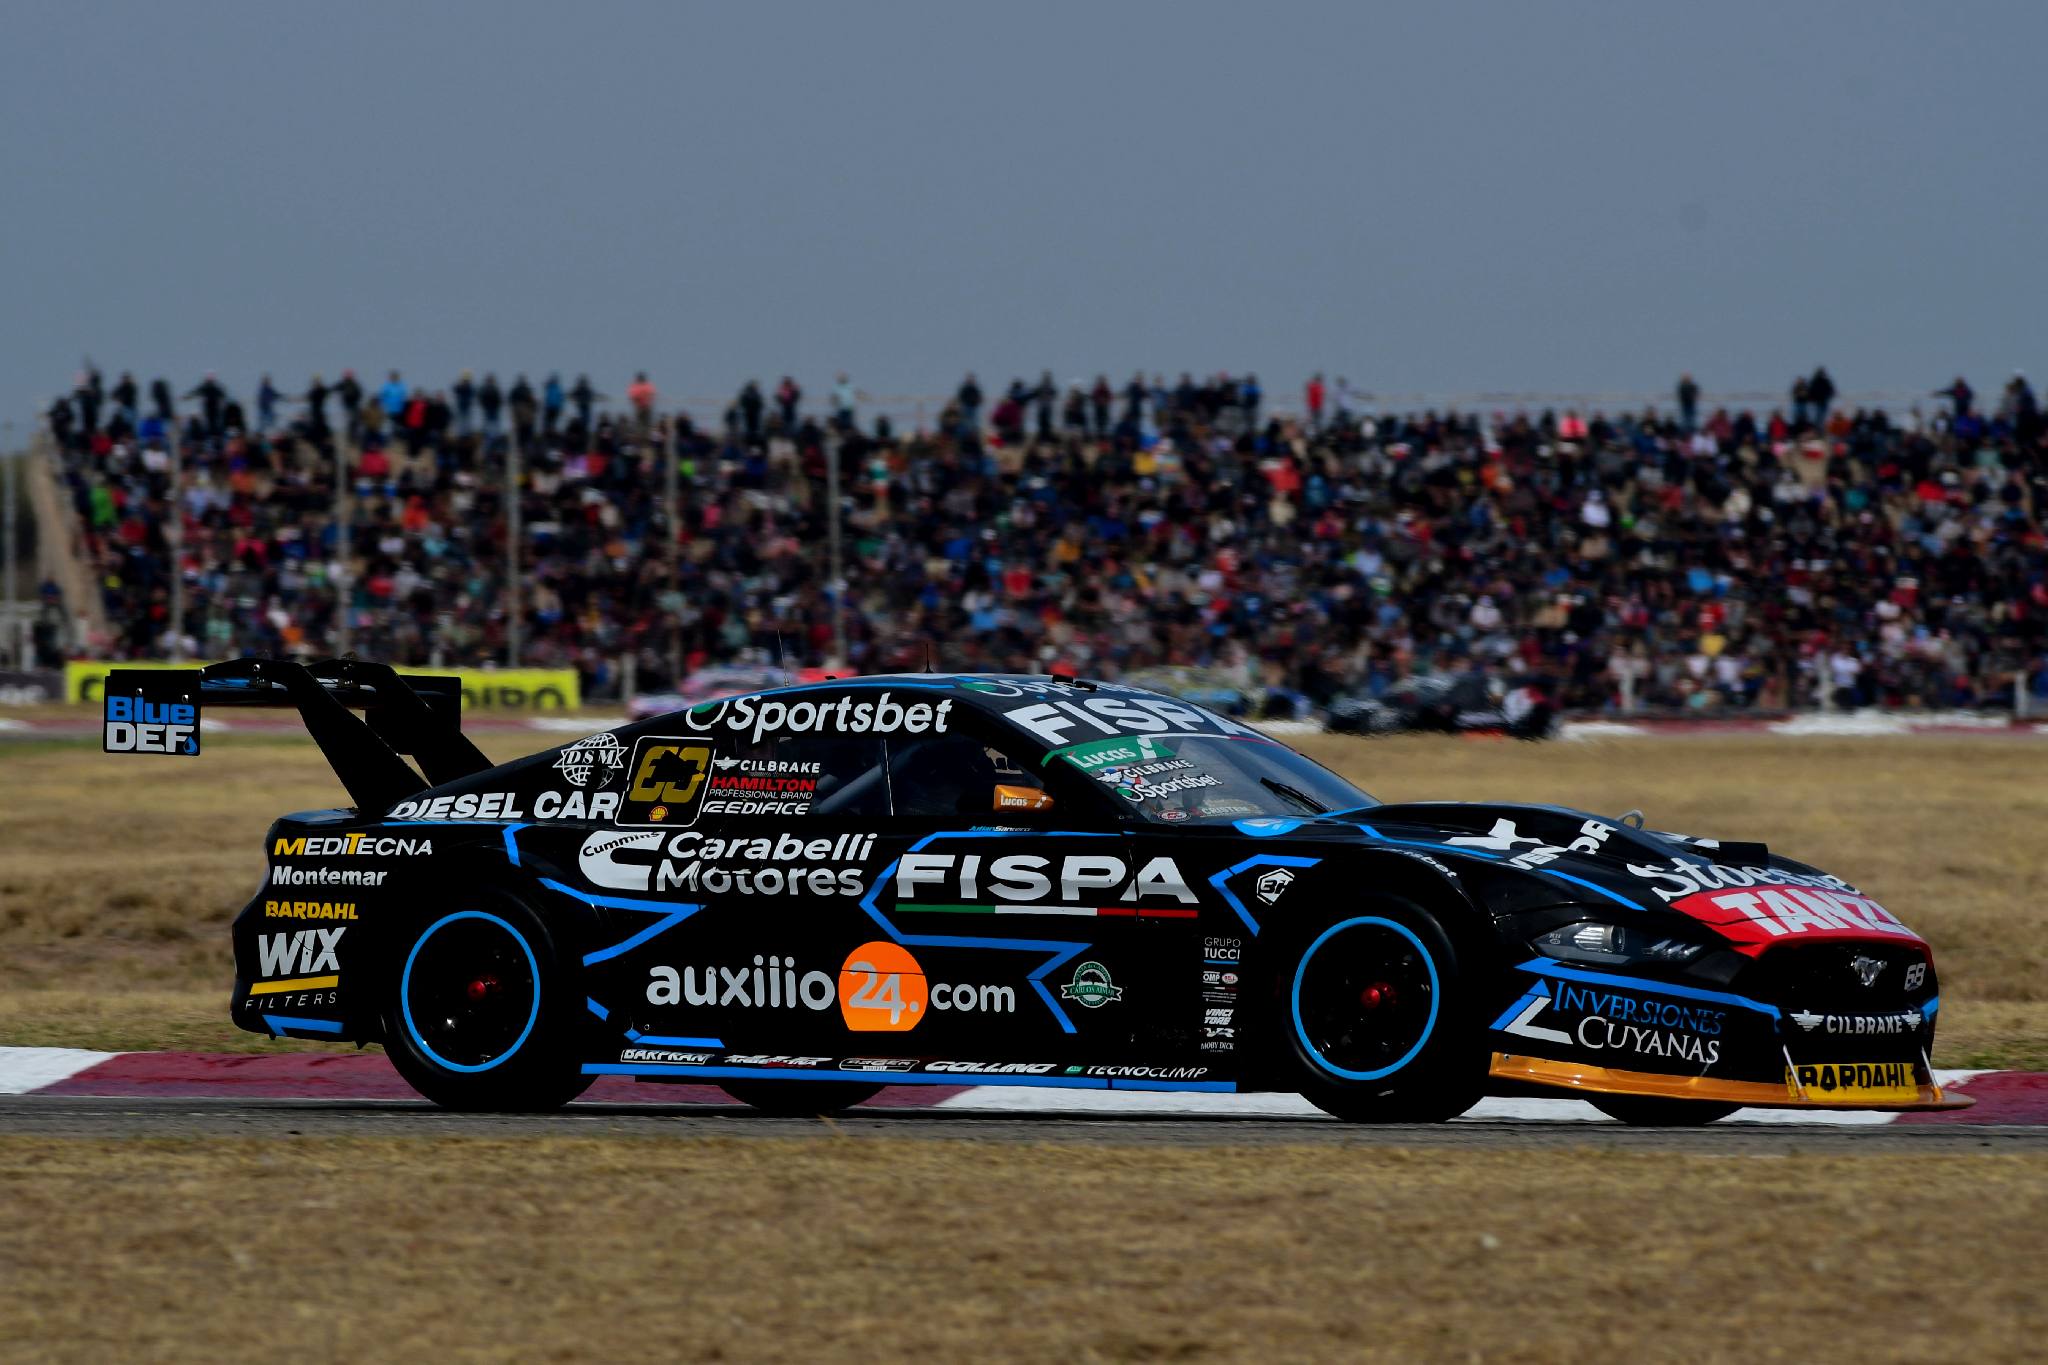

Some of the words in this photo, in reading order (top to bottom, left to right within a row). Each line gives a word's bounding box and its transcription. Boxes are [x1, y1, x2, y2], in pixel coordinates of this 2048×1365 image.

[107, 695, 195, 724] Blue
[726, 692, 953, 744] Sportsbet
[1003, 698, 1250, 746] FISPA
[106, 723, 195, 752] DEF
[567, 749, 617, 765] DSM
[740, 759, 820, 774] CILBRAKE
[1073, 746, 1137, 769] Lucas
[1123, 759, 1195, 780] CILBRAKE
[709, 788, 778, 799] PROFESSIONAL
[780, 789, 813, 800] BRAND
[711, 776, 816, 792] HAMILTON
[1137, 773, 1223, 799] Sportsbet
[387, 792, 524, 820] DIESEL
[533, 790, 619, 820] CAR
[724, 801, 811, 815] EDIFICE
[1000, 794, 1028, 807] Lucas
[582, 830, 660, 857] Cummins
[667, 832, 878, 862] Carabelli
[272, 866, 387, 886] Montemar
[657, 859, 864, 896] Motores
[896, 854, 1200, 904] FISPA
[265, 900, 359, 921] BARDAHL
[258, 926, 347, 977] WIX
[1204, 937, 1241, 948] GRUPO
[1203, 947, 1240, 960] TUCCI
[1203, 973, 1220, 982] OMP
[243, 991, 337, 1011] FILTERS
[1826, 1014, 1903, 1034] CILBRAKE
[1577, 1015, 1721, 1064] CUYANAS
[1086, 1065, 1208, 1079] TECNOCLIMP
